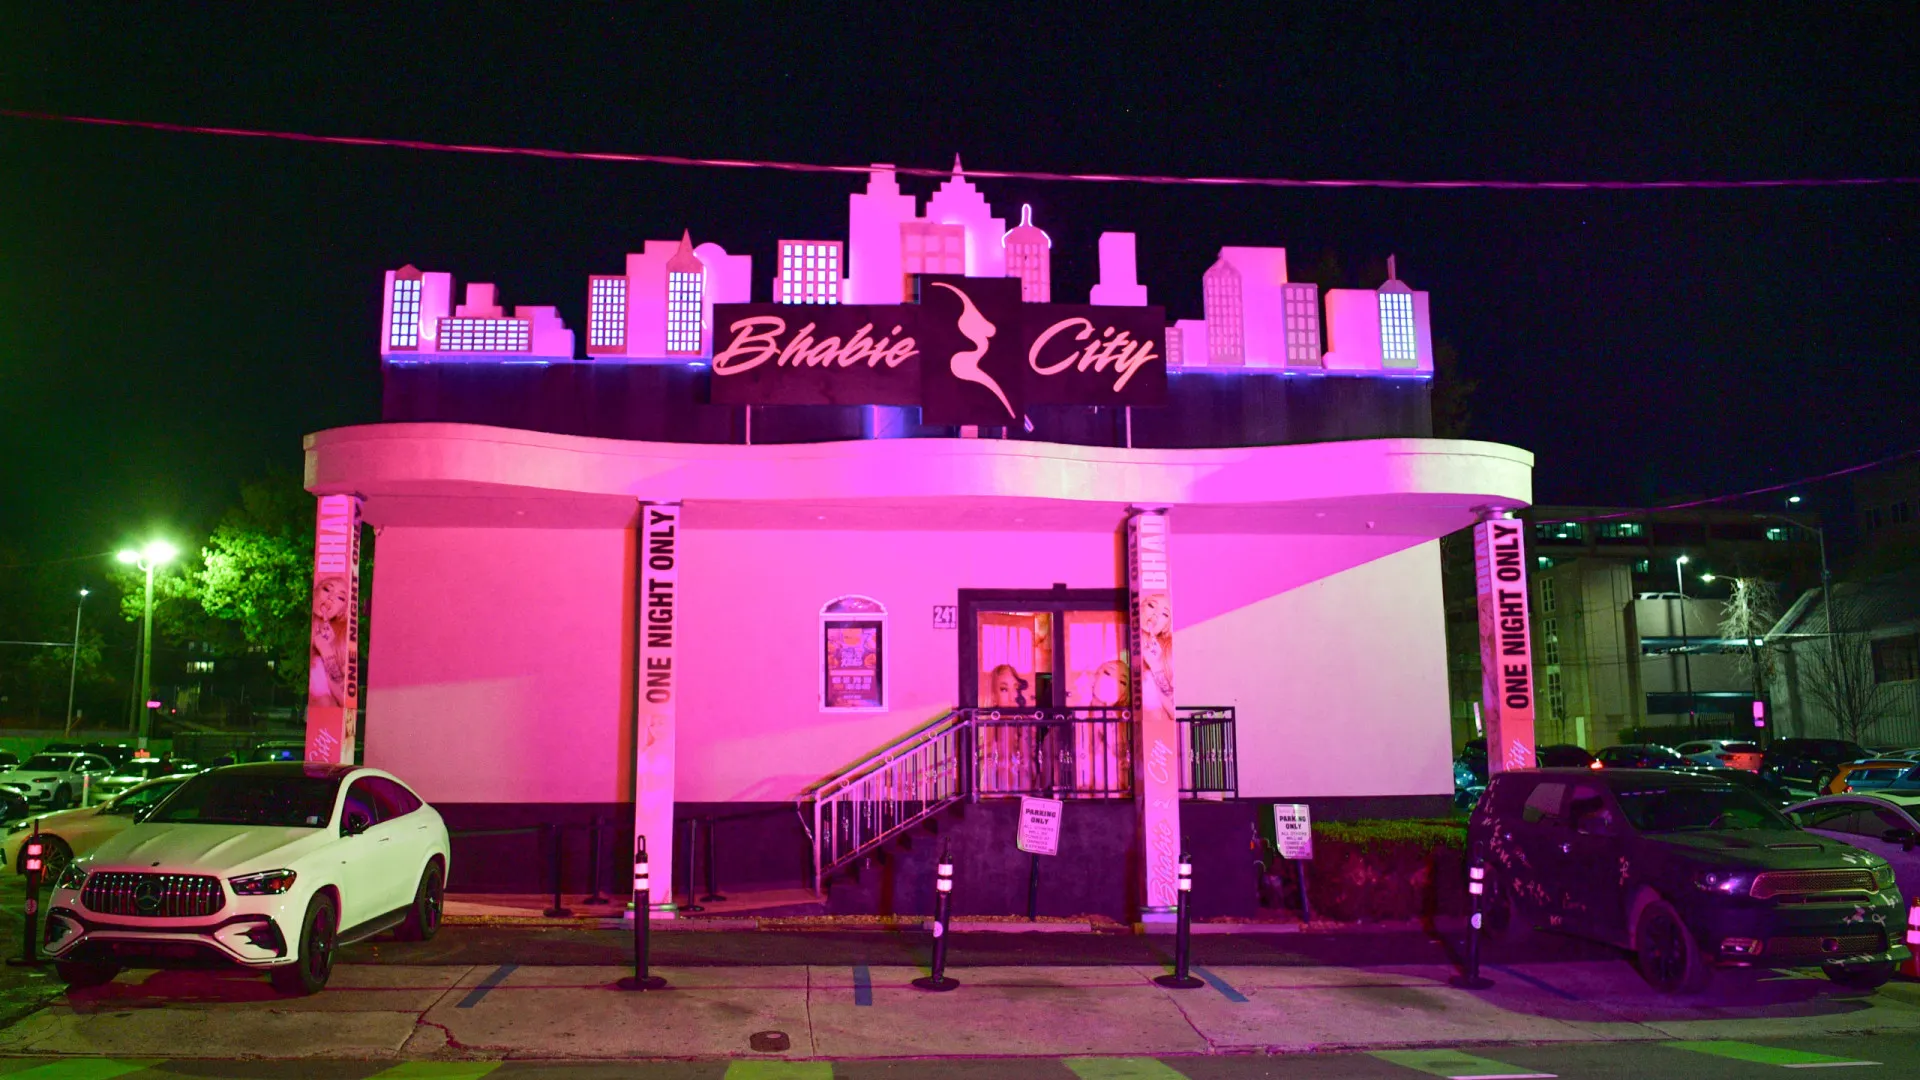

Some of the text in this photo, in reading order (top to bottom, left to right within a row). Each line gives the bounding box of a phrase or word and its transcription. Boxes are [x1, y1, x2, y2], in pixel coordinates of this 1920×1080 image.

[713, 315, 1159, 393] Bhabie City
[347, 502, 362, 698] ONE NIGHT ONLY
[646, 510, 676, 705] ONE NIGHT ONLY
[934, 606, 956, 622] 241
[1494, 523, 1529, 710] ONE NIGHT ONLY
[1148, 739, 1173, 785] City
[1025, 808, 1056, 818] PARKING
[1030, 817, 1050, 825] ONLY
